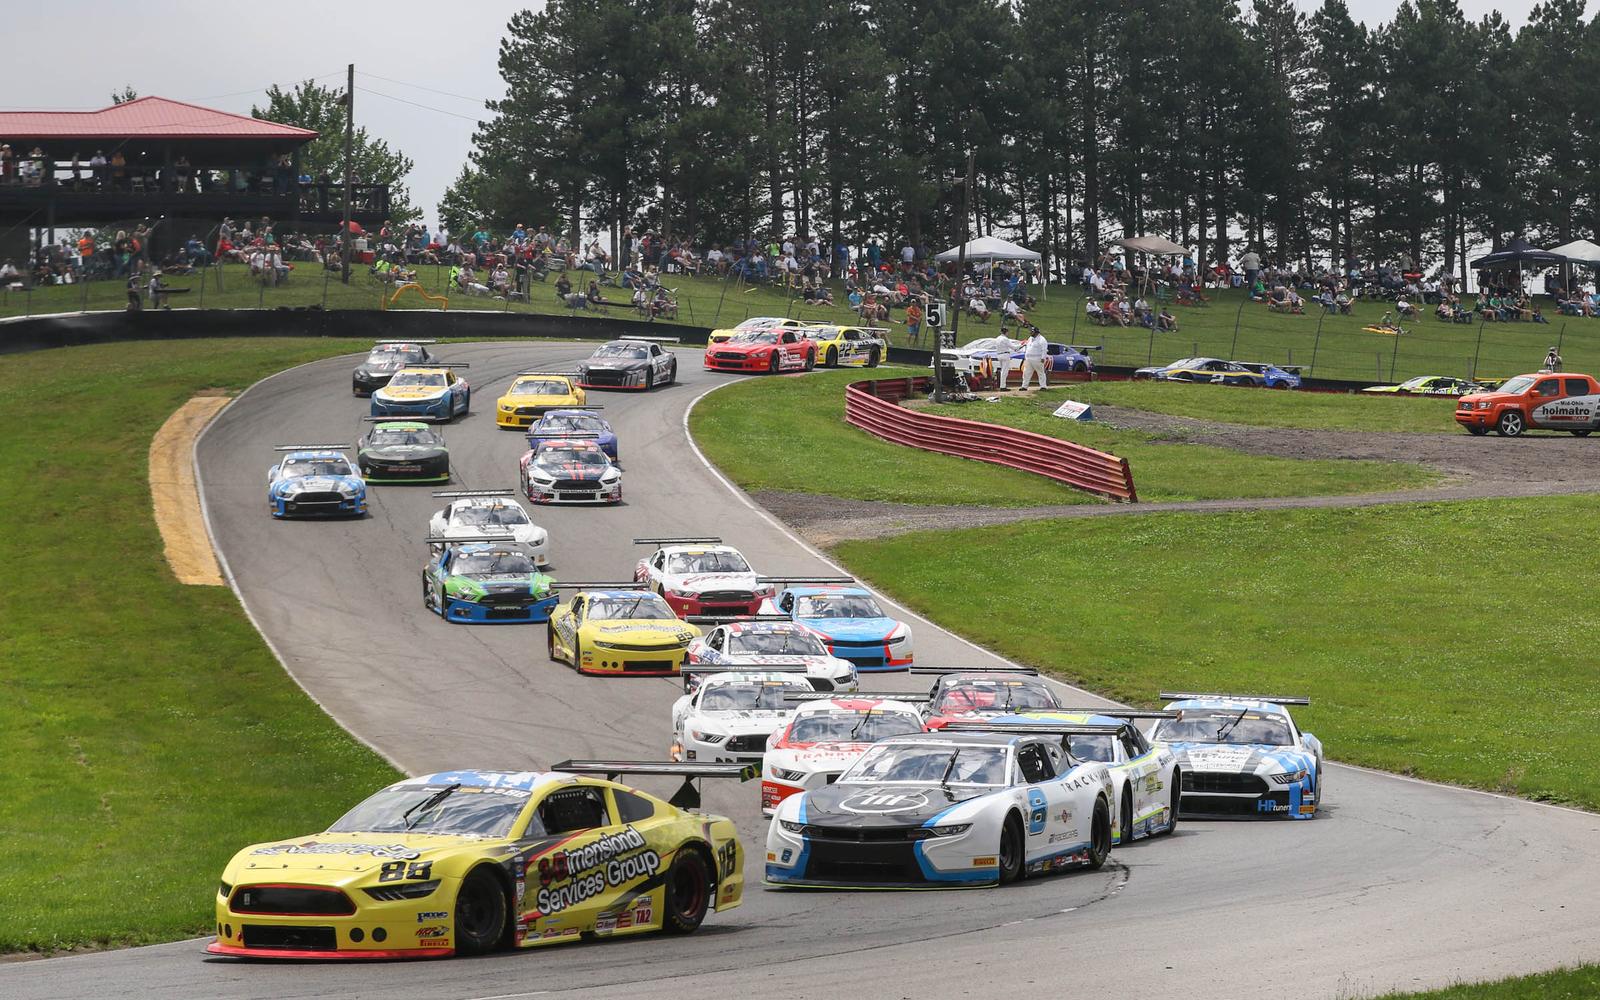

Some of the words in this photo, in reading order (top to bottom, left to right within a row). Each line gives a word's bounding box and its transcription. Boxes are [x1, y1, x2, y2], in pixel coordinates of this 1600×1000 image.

[927, 304, 940, 326] 5
[1542, 406, 1590, 415] holmatro
[378, 860, 434, 883] 88
[537, 873, 605, 916] Services
[606, 850, 661, 887] Group
[635, 909, 651, 924] TA2
